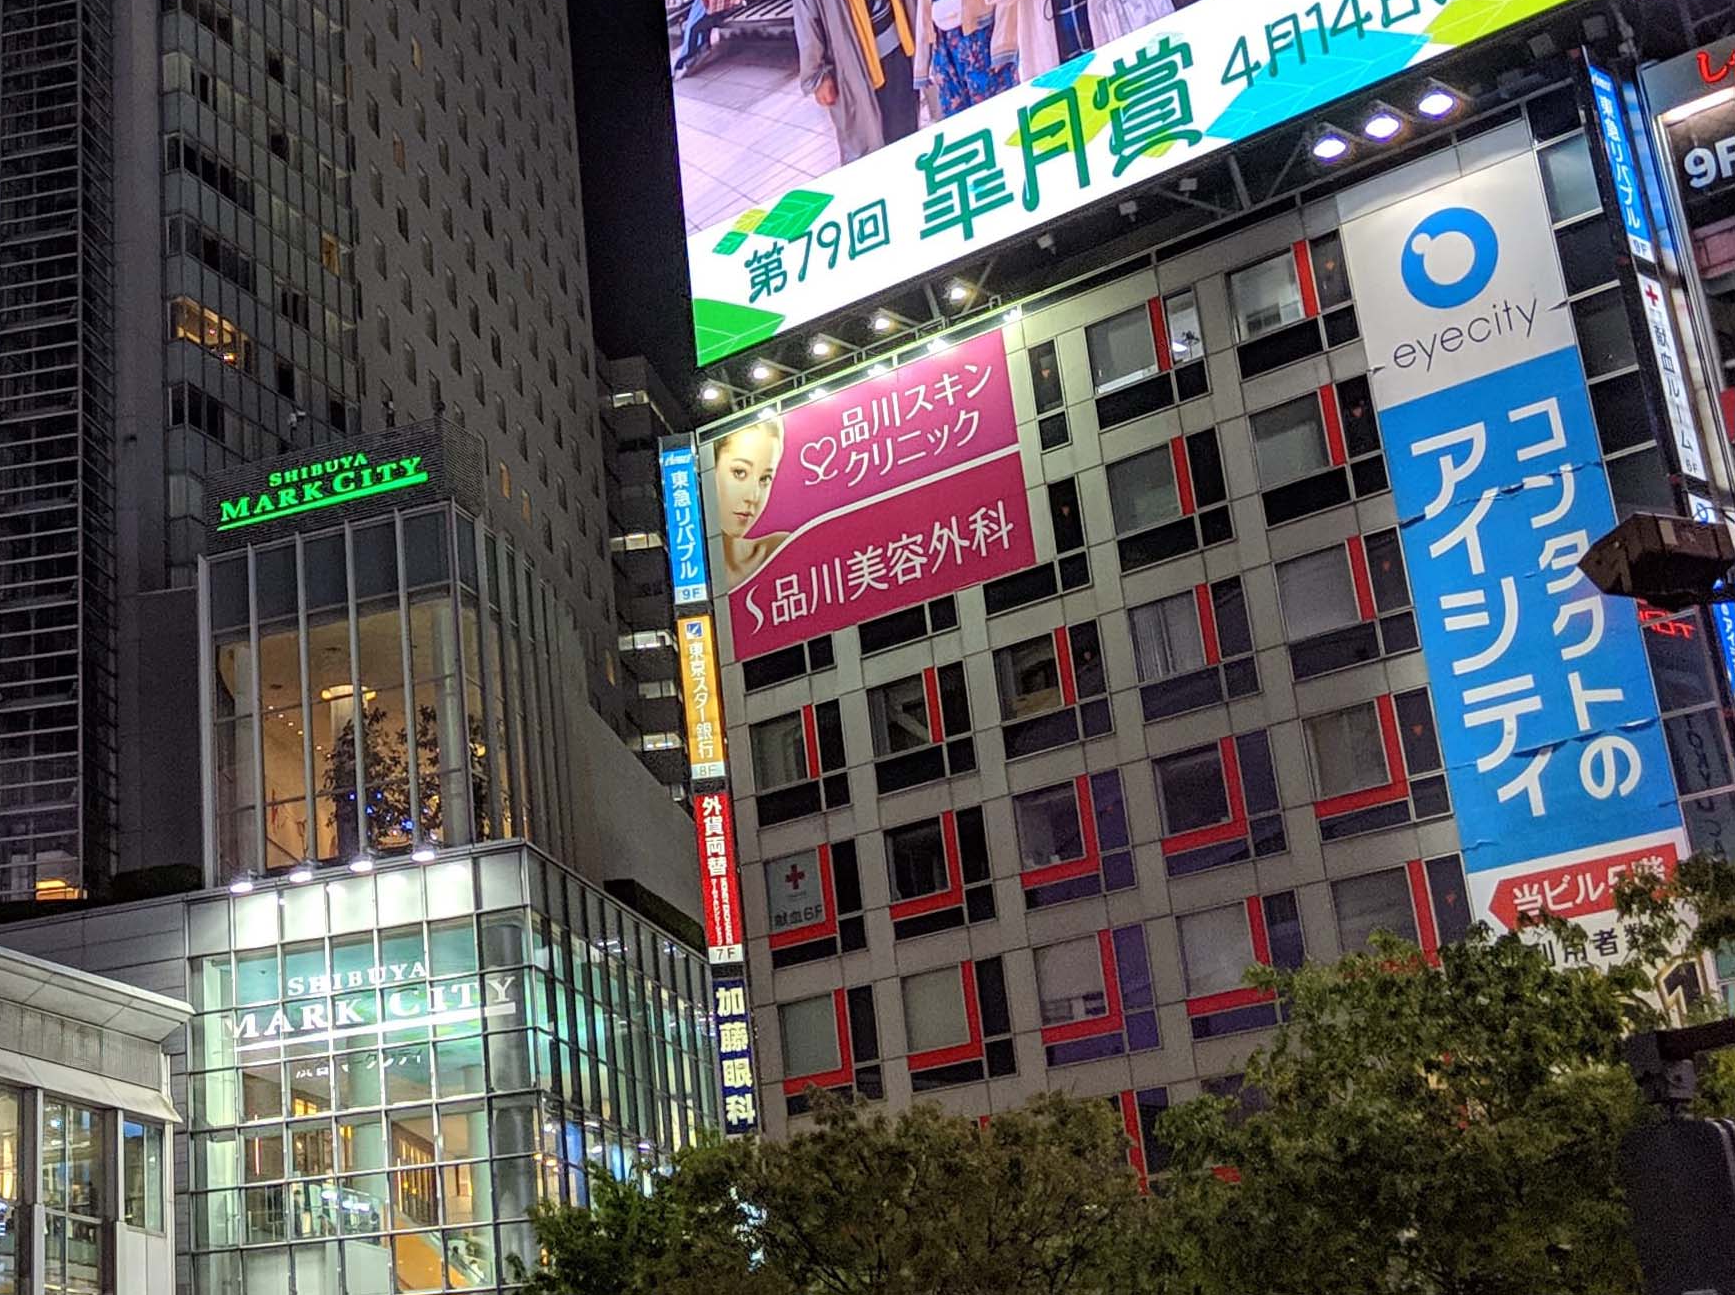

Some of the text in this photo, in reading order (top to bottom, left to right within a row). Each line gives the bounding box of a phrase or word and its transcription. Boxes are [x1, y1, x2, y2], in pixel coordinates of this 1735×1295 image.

[744, 198, 891, 304] 第79回
[915, 36, 1203, 241] 皐月賞
[1599, 95, 1641, 230] 東急リバブル
[1393, 298, 1538, 372] eyecity
[839, 363, 993, 450] 品川スキン
[843, 409, 981, 488] クリニック
[220, 456, 422, 522] MARK CITY
[268, 453, 368, 487] SHIBUYA
[670, 469, 698, 581] 東急リバブル
[770, 500, 1014, 627] 品川美容外科
[681, 587, 701, 600] 9F
[1410, 421, 1547, 818] アイシティ
[1507, 396, 1643, 801] コンタクトの
[688, 640, 714, 759] 東京スター銀行
[702, 795, 728, 877] 外貨両替
[287, 961, 426, 996] SHIBUYA
[716, 948, 736, 961] 7F
[224, 976, 515, 1039] MARK CITY
[715, 987, 756, 1127] 加藤眼科
